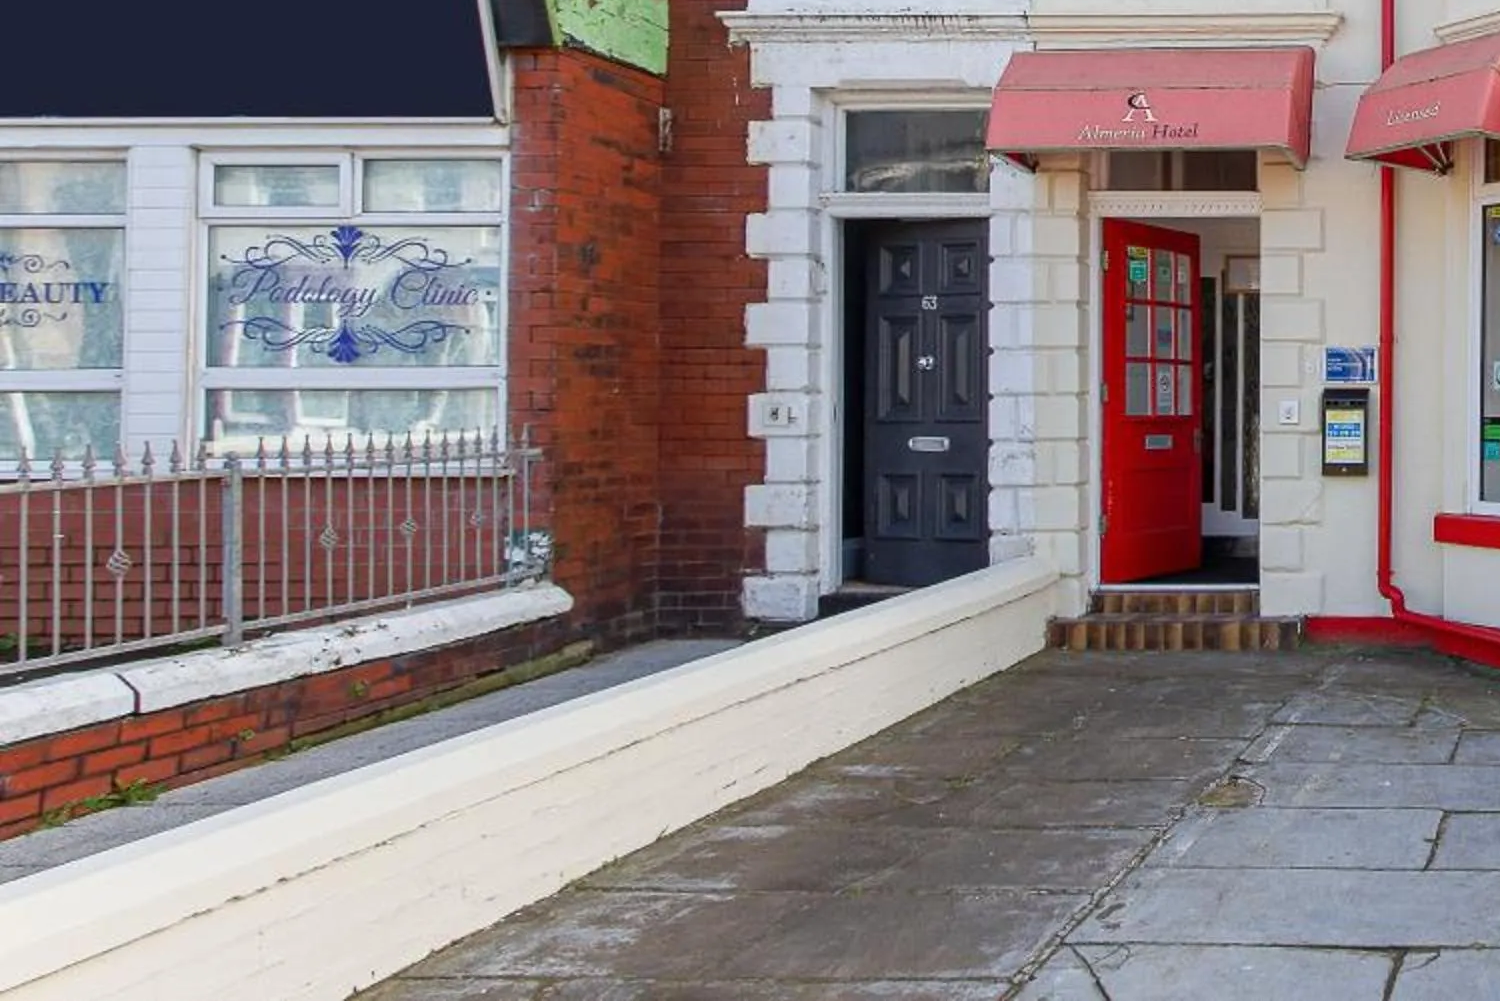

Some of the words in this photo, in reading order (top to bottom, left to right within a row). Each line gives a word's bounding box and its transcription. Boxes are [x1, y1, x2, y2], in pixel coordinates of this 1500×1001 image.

[1078, 124, 1146, 140] Almeria
[1151, 123, 1200, 139] Hotel
[229, 268, 378, 318] Podology
[391, 269, 479, 310] Clinic
[922, 296, 938, 310] 63
